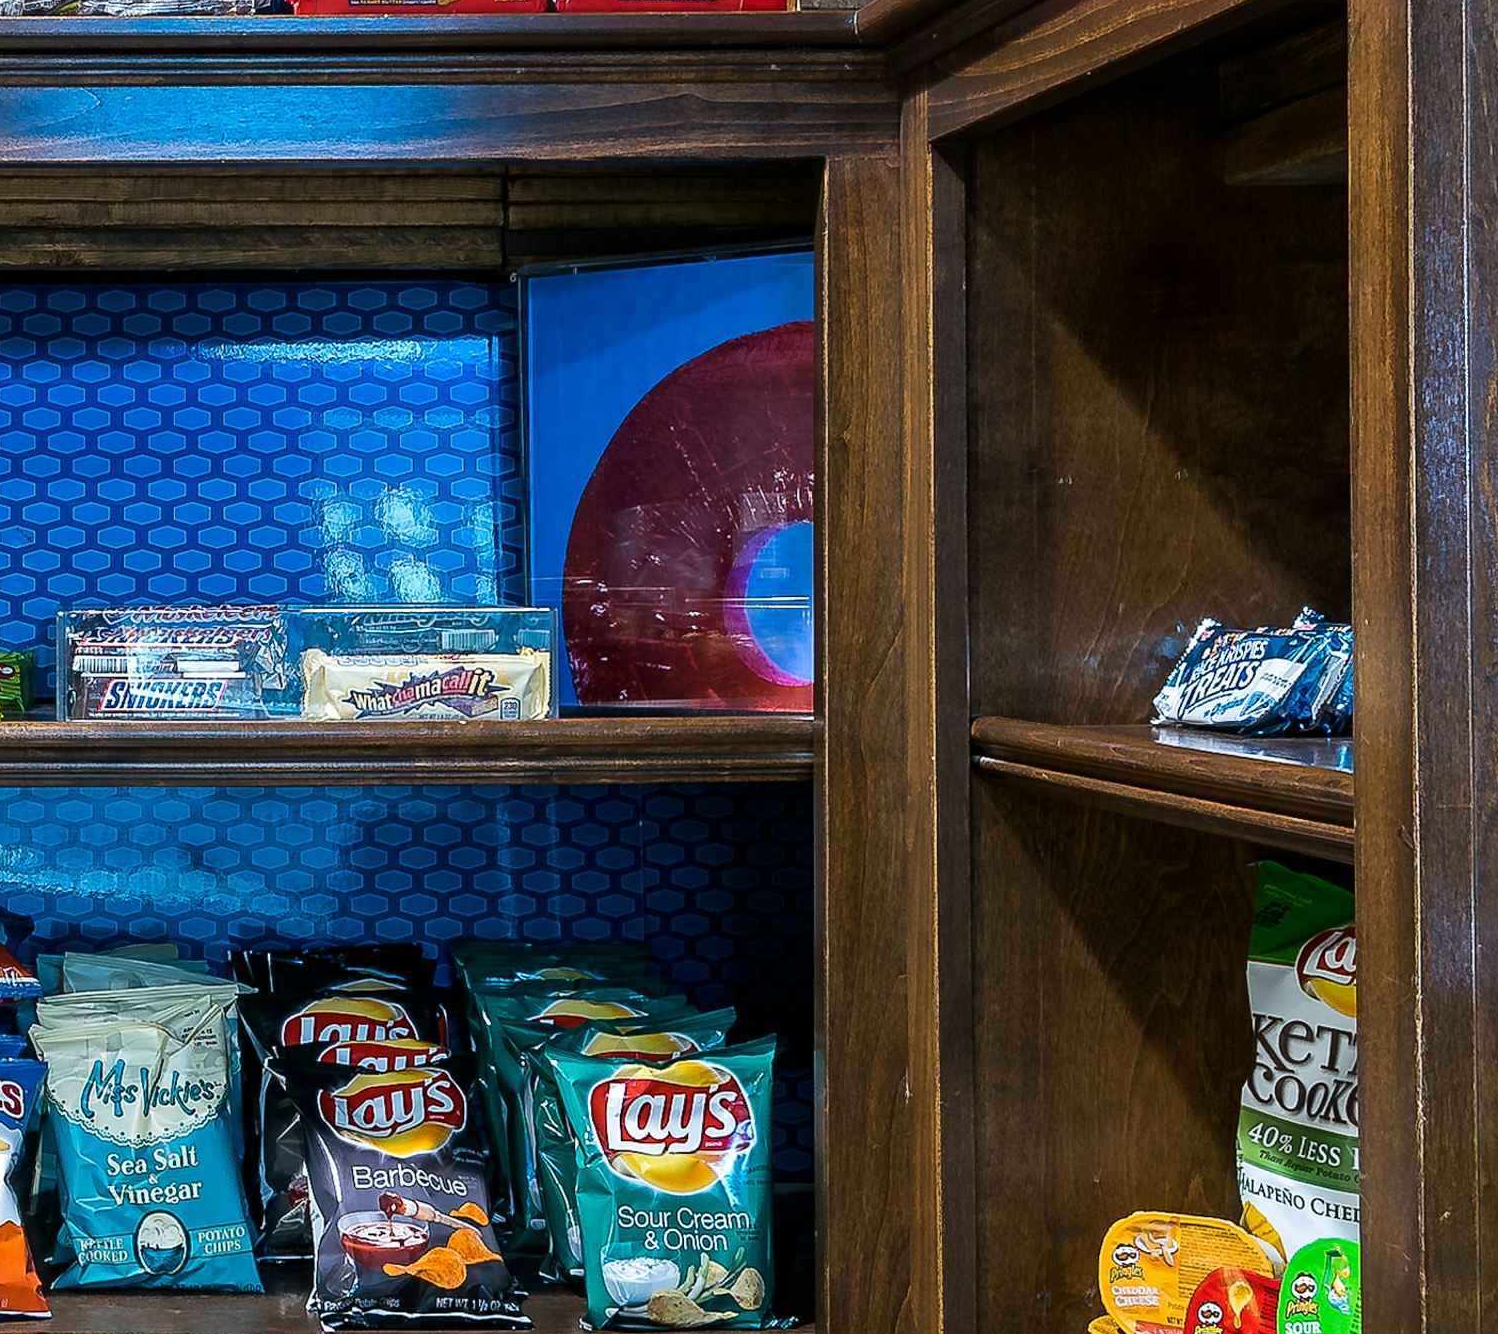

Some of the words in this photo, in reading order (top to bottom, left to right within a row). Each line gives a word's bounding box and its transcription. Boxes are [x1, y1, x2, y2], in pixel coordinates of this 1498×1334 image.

[105, 681, 222, 709] SNICKERS
[353, 668, 494, 711] Whatchamacallit
[1178, 661, 1261, 720] TREATS
[82, 1059, 134, 1119] Miss
[137, 1066, 215, 1119] Vickie's
[334, 1077, 454, 1138] Lay's
[605, 1077, 739, 1154] Lay's
[1248, 1122, 1293, 1154] 40%
[1297, 1136, 1341, 1166] LESS
[107, 1153, 148, 1179] Sea
[153, 1145, 199, 1172] Salt
[1260, 1150, 1283, 1166] Than
[1316, 1167, 1351, 1182] Potato
[148, 1173, 160, 1184] &
[351, 1165, 468, 1197] Barbecue
[1242, 1173, 1305, 1210] JALAPEÑO
[107, 1179, 203, 1208] Vinegar
[617, 1206, 673, 1231] Sour
[675, 1206, 750, 1231] Cream
[79, 1238, 124, 1252] KETTLE
[197, 1226, 246, 1243] POTATO
[204, 1238, 242, 1255] CHIPS
[643, 1231, 660, 1252] &
[662, 1230, 728, 1252] Onion
[77, 1249, 129, 1265] COOKED
[1109, 1265, 1144, 1283] Pringles
[436, 1298, 453, 1308] NET
[1111, 1285, 1159, 1296] CHEDDAR
[1115, 1296, 1160, 1307] CHEESE
[1285, 1300, 1319, 1318] Pringles
